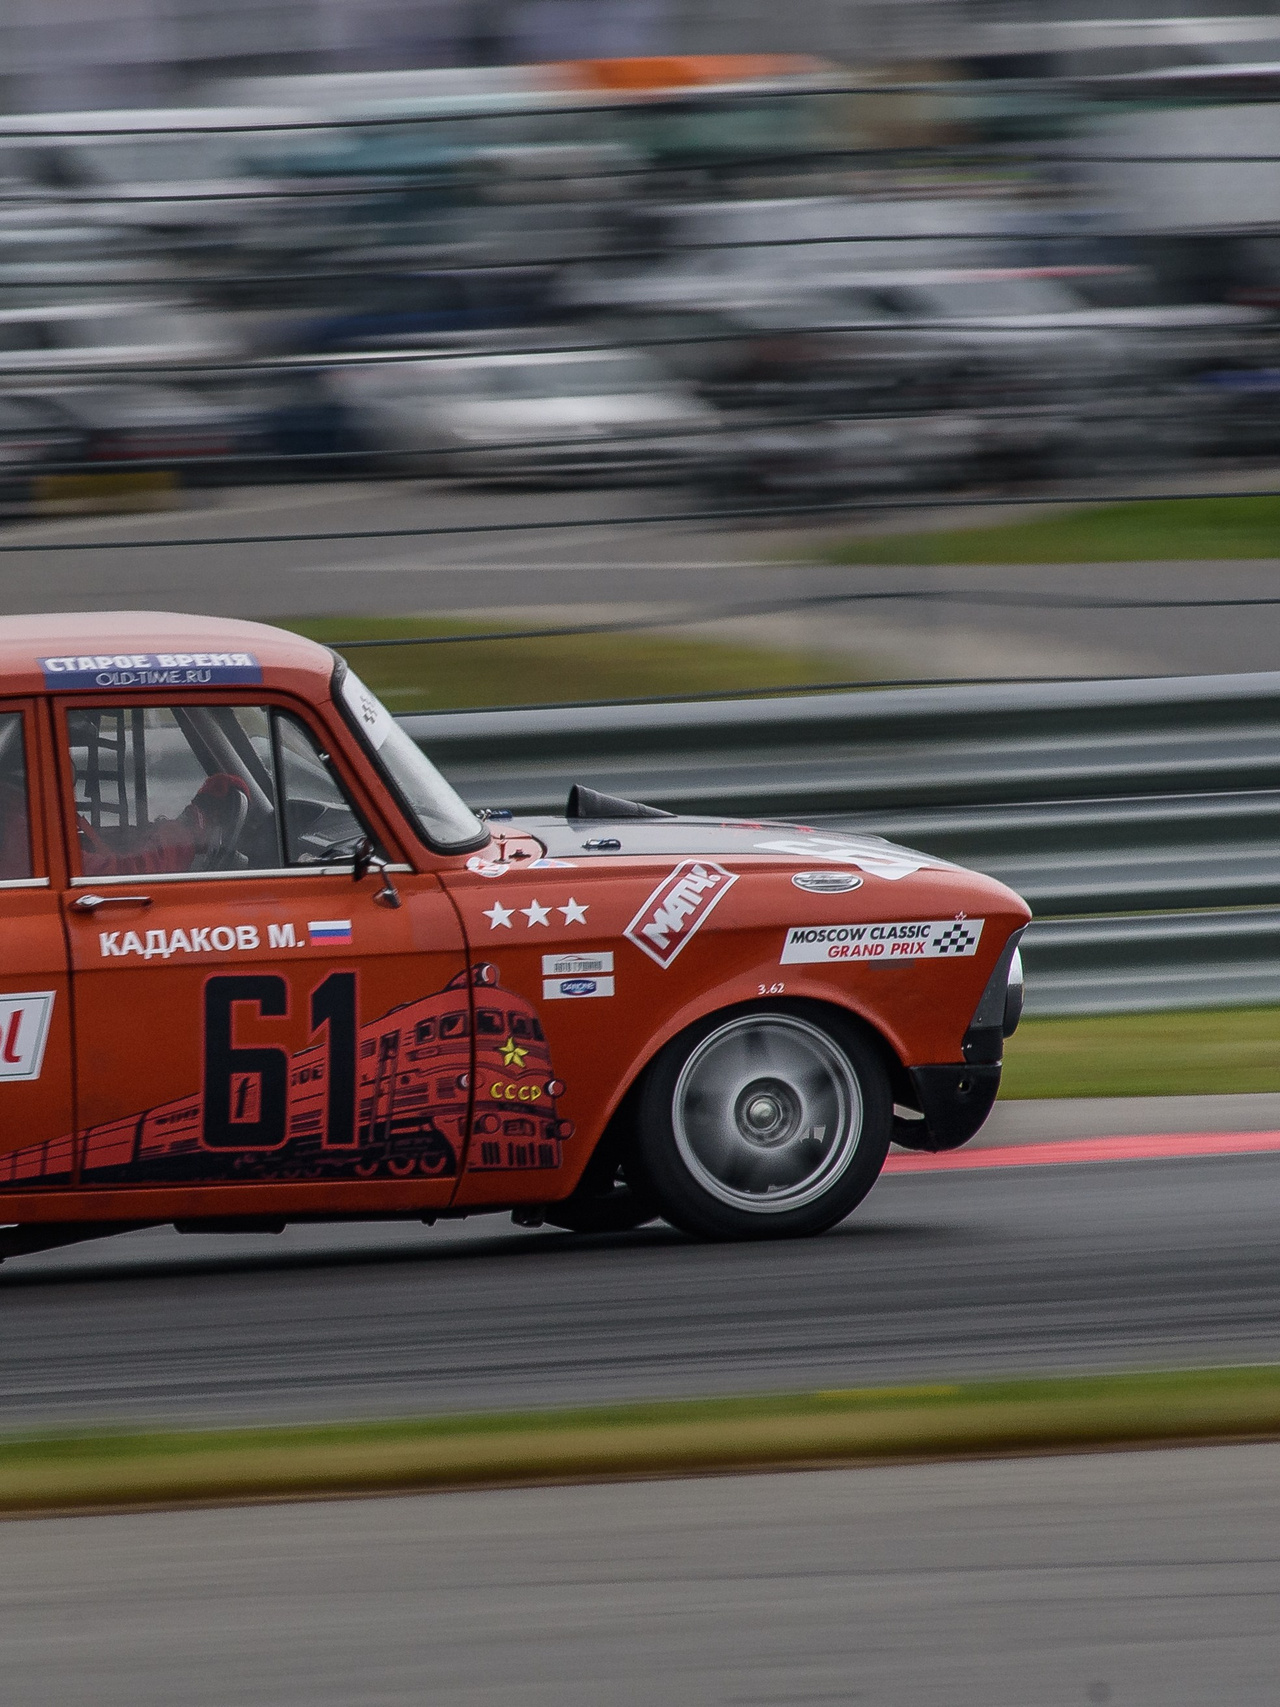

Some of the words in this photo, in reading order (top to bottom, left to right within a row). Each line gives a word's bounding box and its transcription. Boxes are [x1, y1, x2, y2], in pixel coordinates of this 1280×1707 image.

[44, 655, 152, 672] СТАРОЕ
[155, 652, 254, 669] ВРЕМЯ
[95, 669, 212, 686] OLD-TIME.RU
[98, 924, 261, 960] КАДАКОВ
[267, 922, 307, 948] М.
[790, 927, 868, 945] MOSCOW
[870, 924, 931, 941] CLASSIC
[828, 943, 885, 959] GRAND
[890, 941, 926, 956] PRIX
[757, 982, 785, 995] 3.62
[202, 967, 360, 1152] 61
